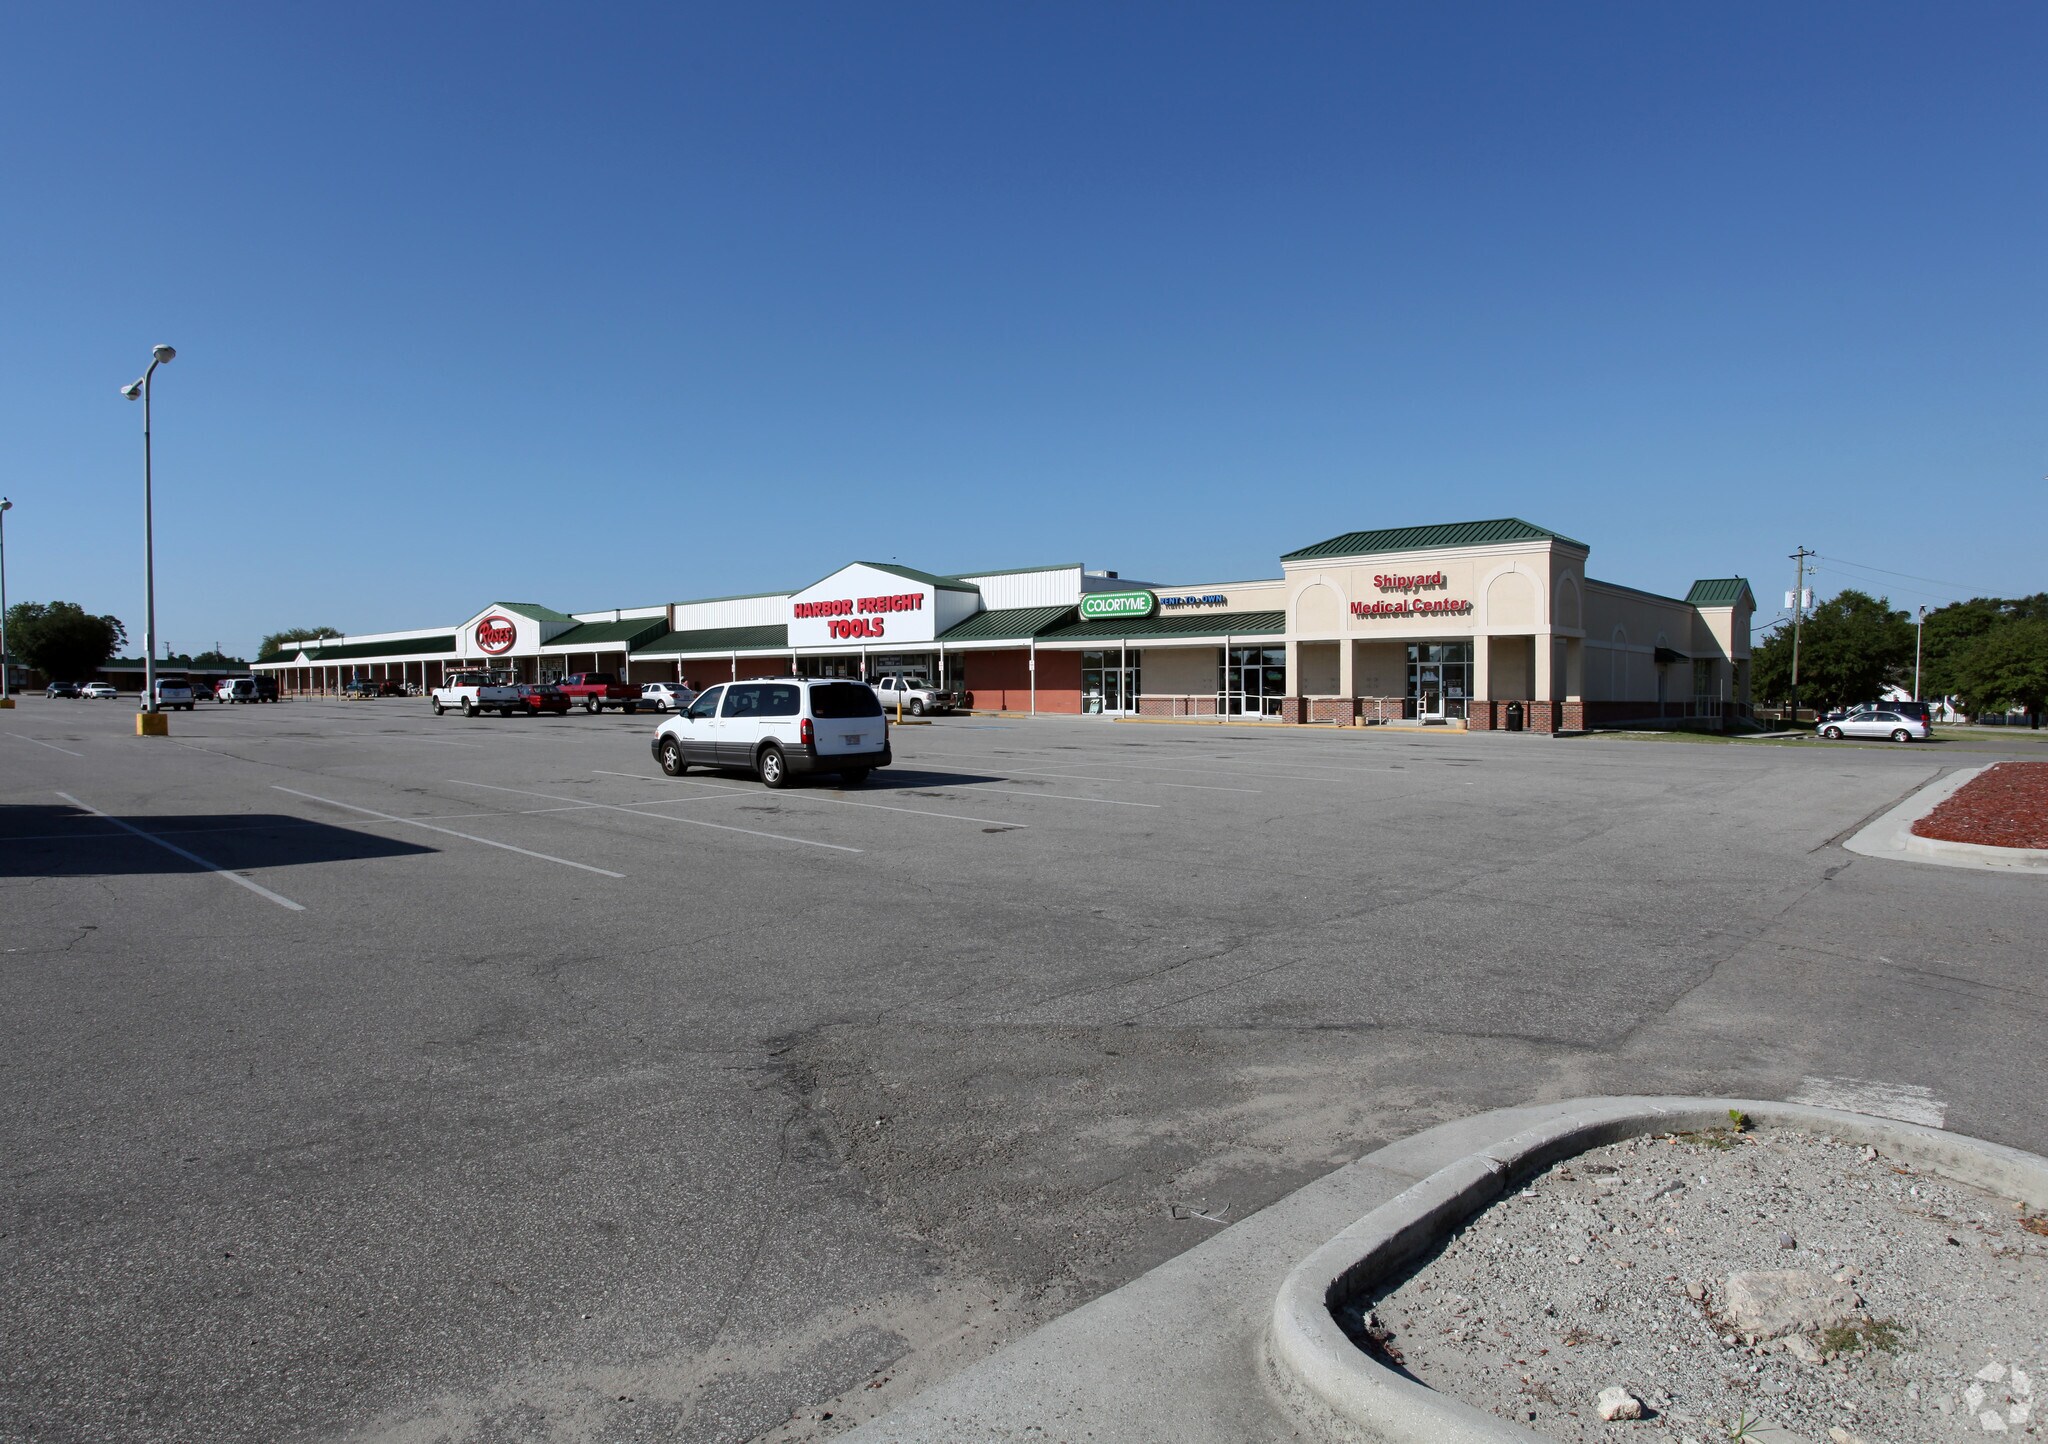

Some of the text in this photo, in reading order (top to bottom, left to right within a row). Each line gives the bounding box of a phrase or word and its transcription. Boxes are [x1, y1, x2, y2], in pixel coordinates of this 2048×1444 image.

[1373, 571, 1442, 589] Shipyard
[793, 593, 924, 619] HARBOR FREIGHT
[1086, 597, 1147, 612] COLORTYME
[1350, 598, 1468, 615] Medical Center
[827, 617, 885, 639] TOOLS
